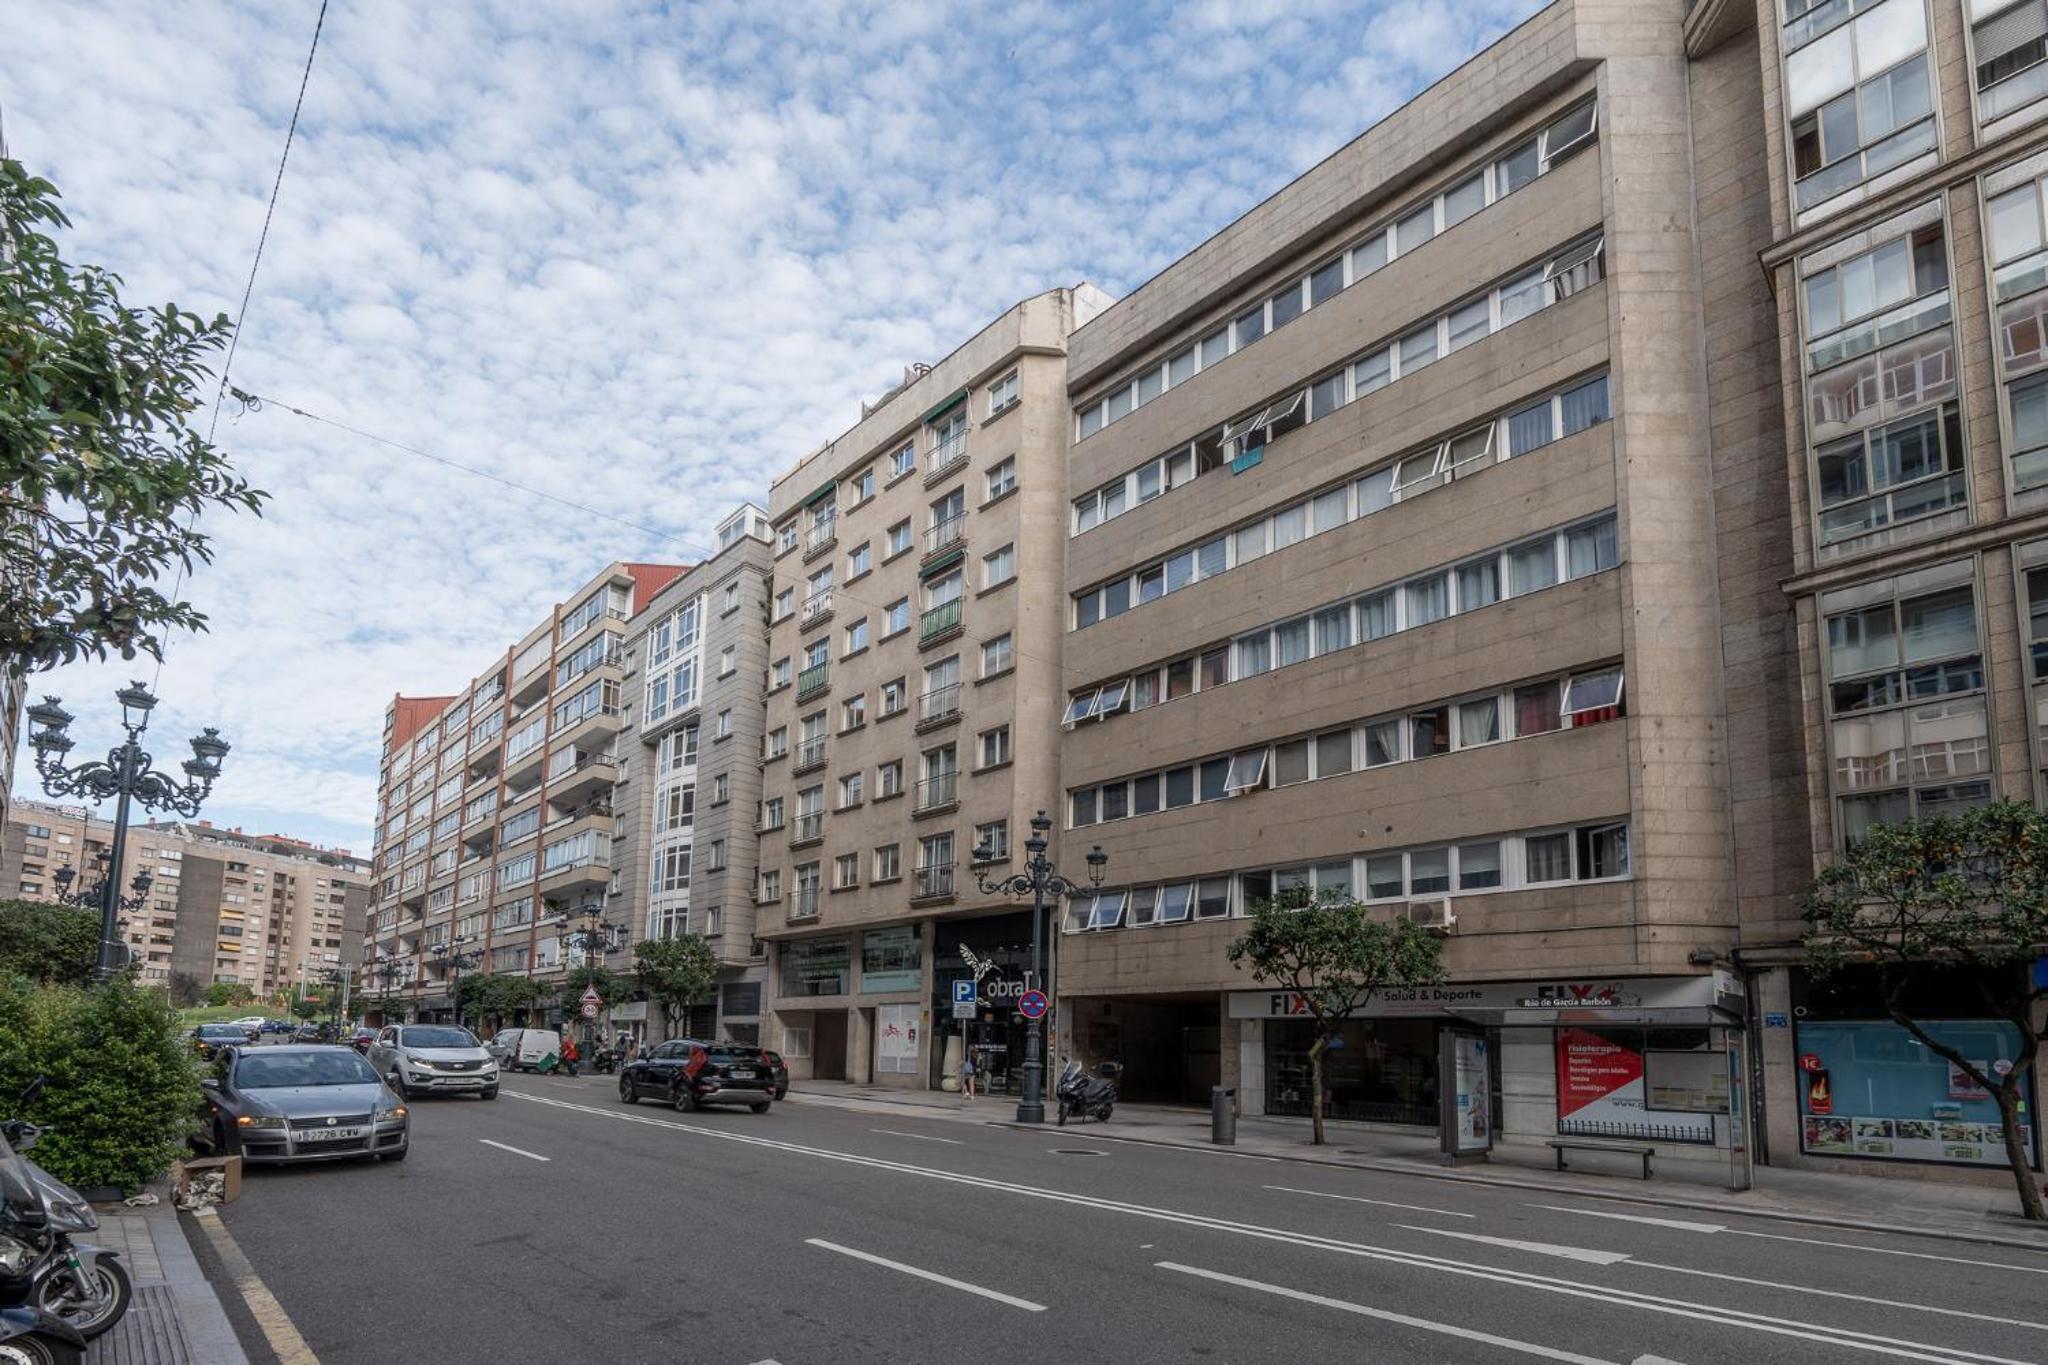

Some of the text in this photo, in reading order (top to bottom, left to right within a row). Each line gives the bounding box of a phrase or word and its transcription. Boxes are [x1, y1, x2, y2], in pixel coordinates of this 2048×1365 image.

[956, 982, 971, 1000] P
[1384, 990, 1483, 1003] Salud & Deporte
